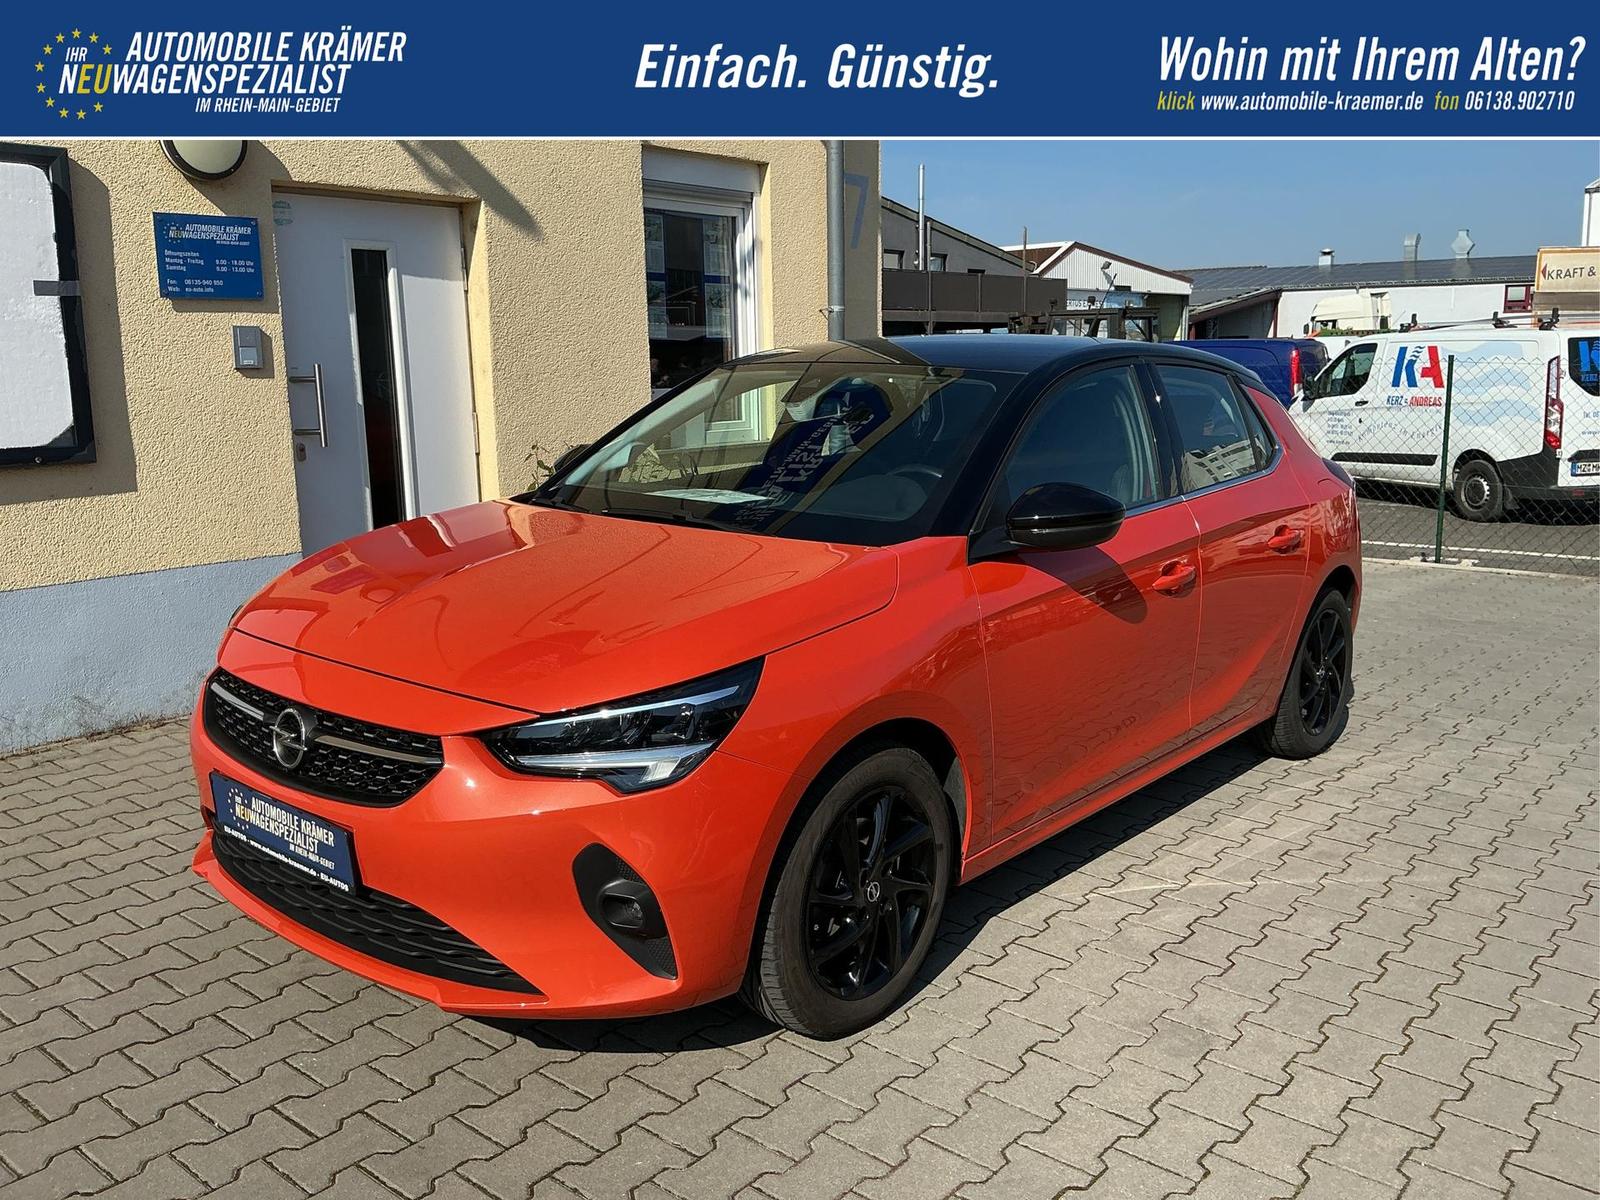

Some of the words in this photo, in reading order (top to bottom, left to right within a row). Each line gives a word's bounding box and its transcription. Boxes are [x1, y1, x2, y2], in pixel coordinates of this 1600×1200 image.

[169, 230, 240, 241] NEUWAGENSPEZIALIST
[185, 223, 225, 233] AUTOMOBILE
[225, 224, 252, 235] KRÄMER
[1547, 267, 1585, 280] KRAFT
[1587, 266, 1596, 277] &
[1386, 395, 1404, 406] KERZ
[1409, 395, 1443, 407] ANDREAS
[251, 796, 300, 831] AUTOMOBILE
[300, 818, 335, 848] KRÄMER
[235, 803, 319, 855] NEUWAGENSPEZIALIST
